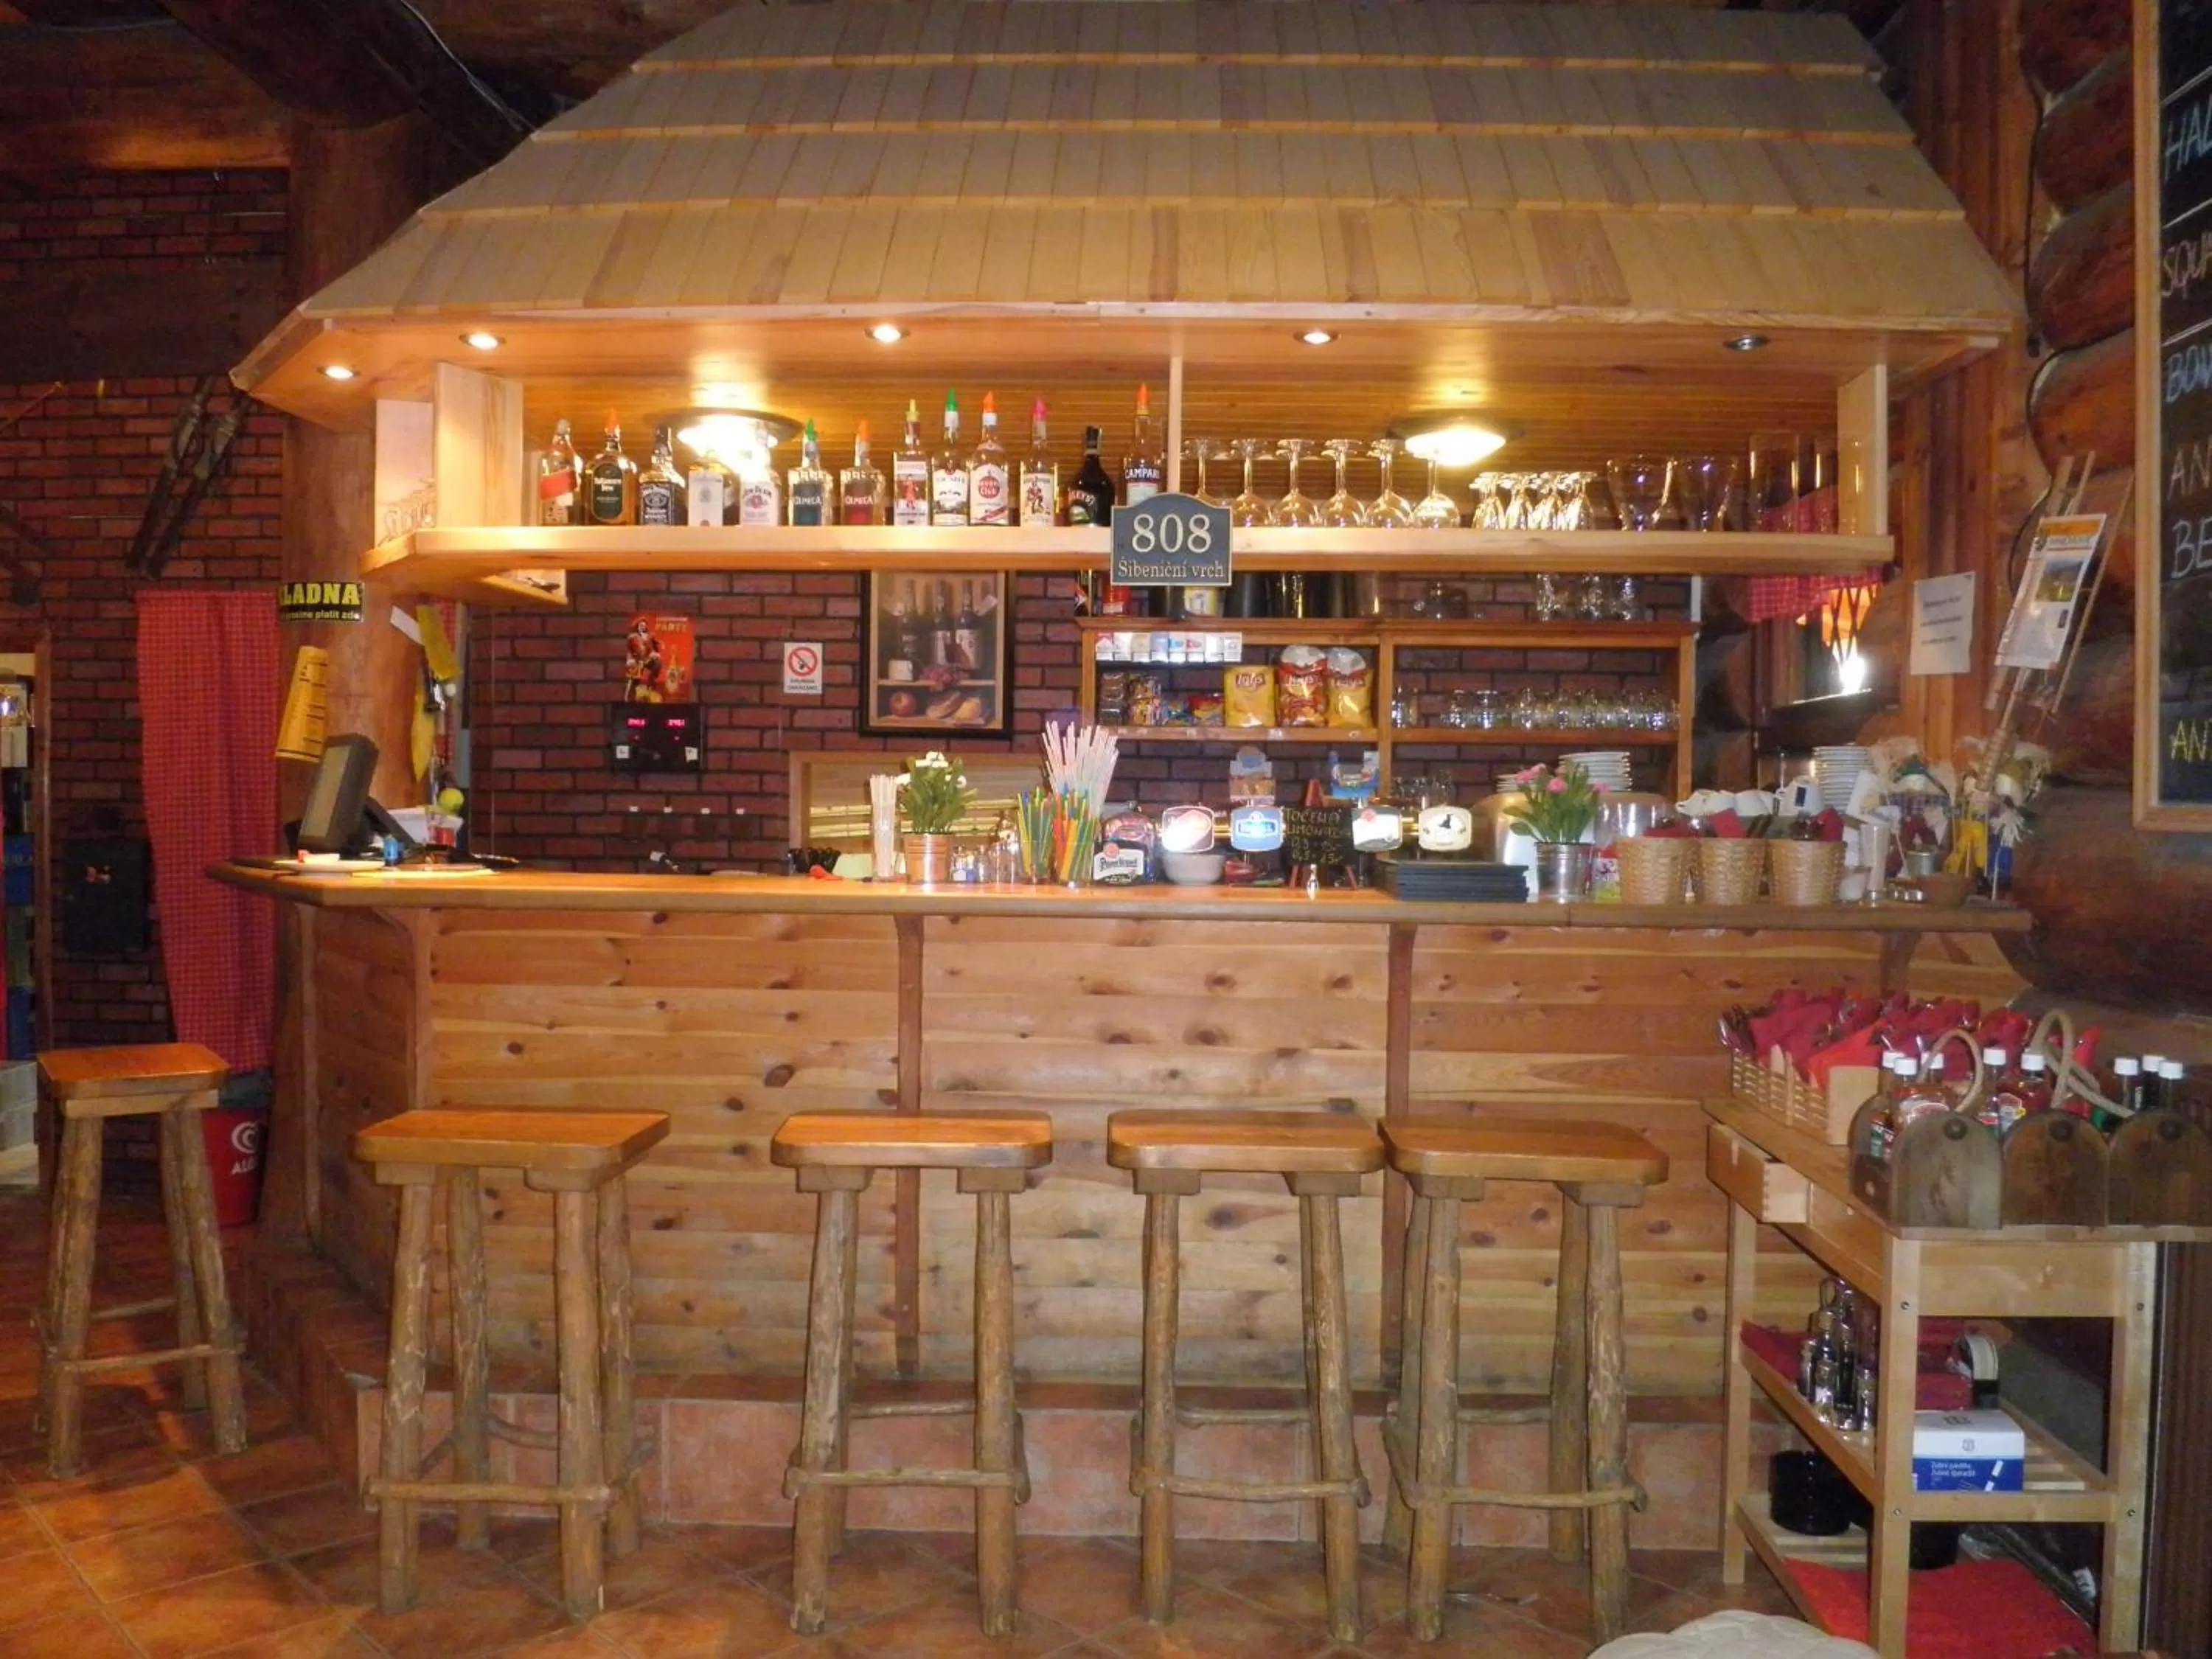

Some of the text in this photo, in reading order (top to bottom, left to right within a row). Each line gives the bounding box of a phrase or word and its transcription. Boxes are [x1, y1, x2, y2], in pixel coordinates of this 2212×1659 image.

[1132, 513, 1211, 553] 808
[1118, 556, 1225, 577] Šibeniční vrch
